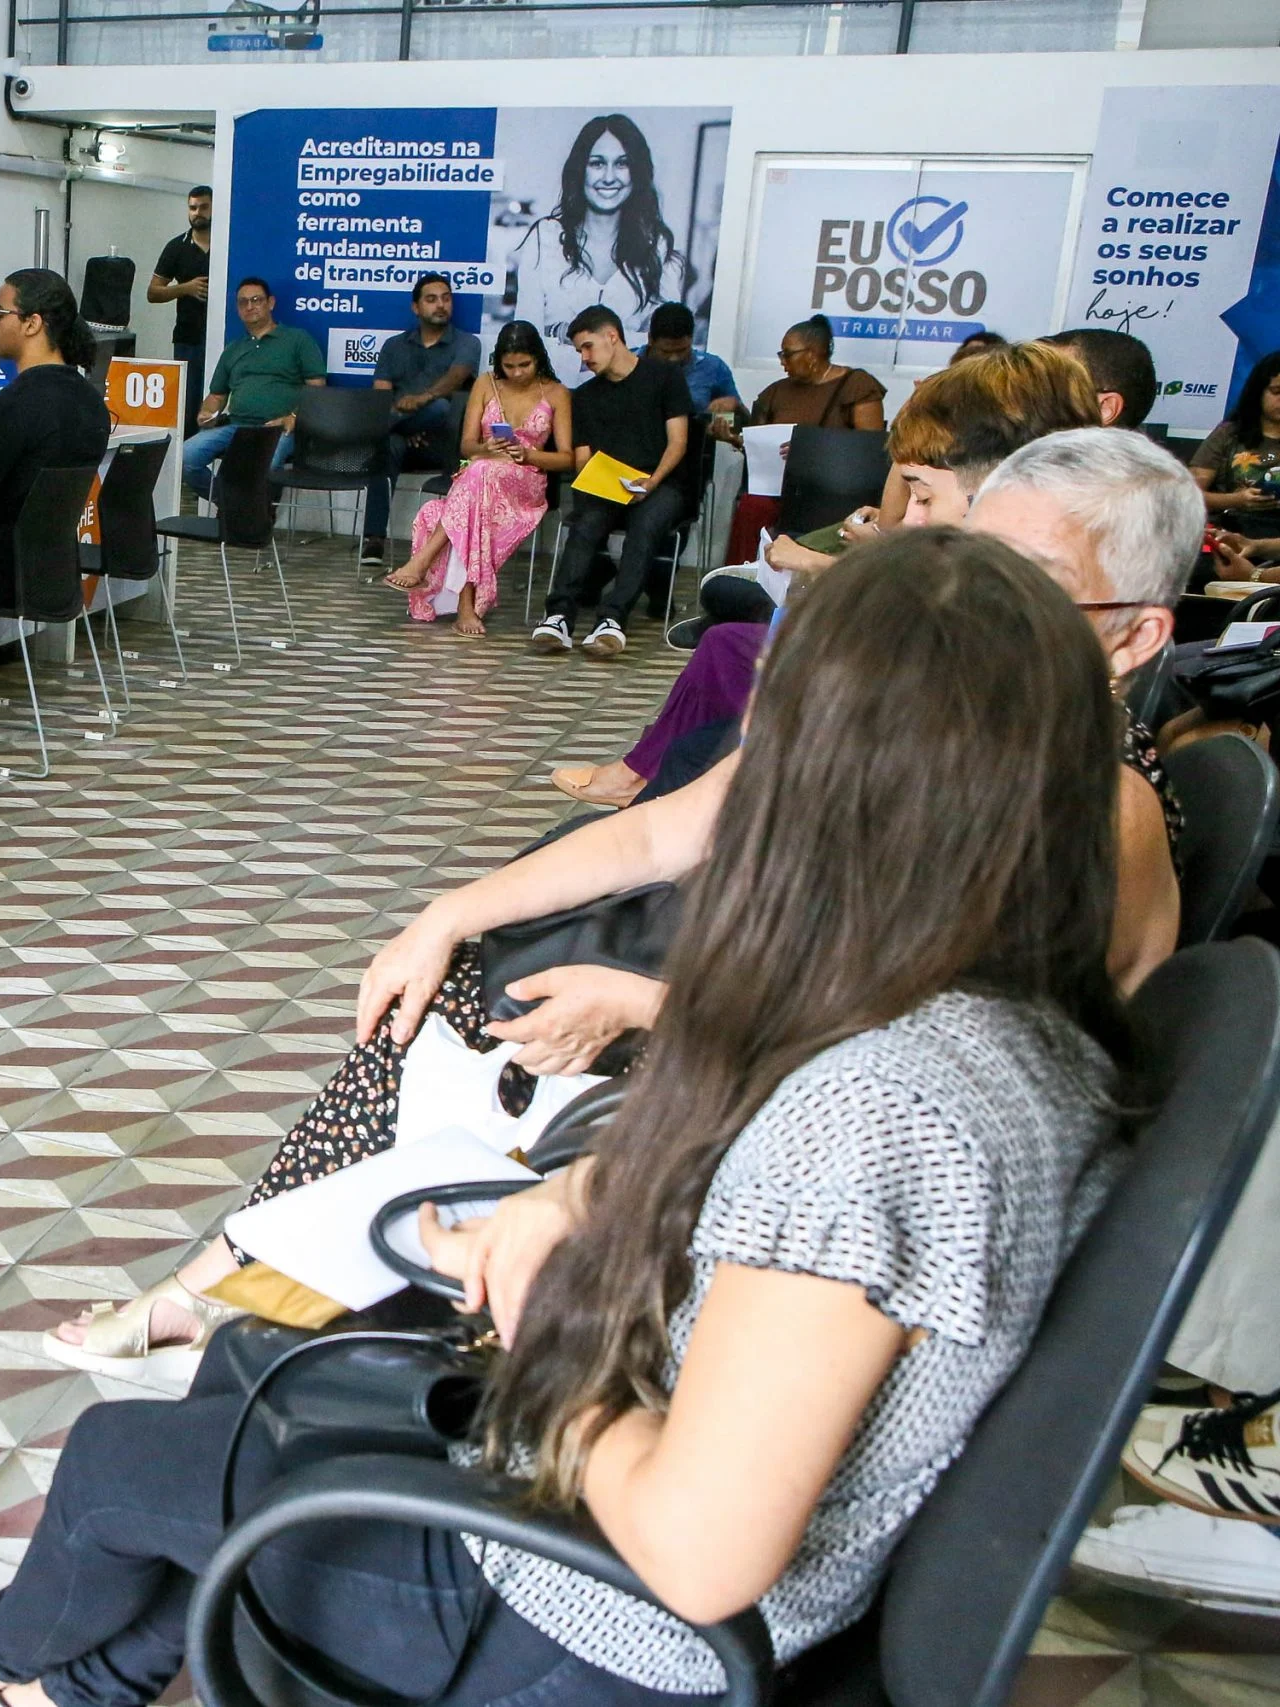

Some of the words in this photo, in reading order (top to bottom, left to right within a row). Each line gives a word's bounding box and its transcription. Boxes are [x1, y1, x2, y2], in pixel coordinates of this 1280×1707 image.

[300, 136, 446, 157] Acreditamos
[451, 141, 480, 157] na
[300, 163, 495, 186] Empregabilidade
[298, 192, 361, 207] como
[1107, 187, 1230, 208] Comece
[297, 212, 423, 233] ferramenta
[1101, 216, 1118, 233] a
[1127, 212, 1241, 236] realizar
[296, 238, 441, 259] fundamental
[816, 219, 885, 265] EU
[1097, 243, 1131, 259] os
[1138, 243, 1208, 261] seus
[295, 262, 322, 281] de
[1092, 266, 1200, 287] sonhos
[810, 266, 987, 317] POSSO
[295, 293, 364, 313] social.
[1085, 288, 1174, 335] hoje!
[840, 321, 953, 337] TRABALHAR
[345, 339, 360, 350] EU
[344, 350, 380, 363] POSSO
[125, 372, 165, 409] 08
[1183, 383, 1218, 395] SINE
